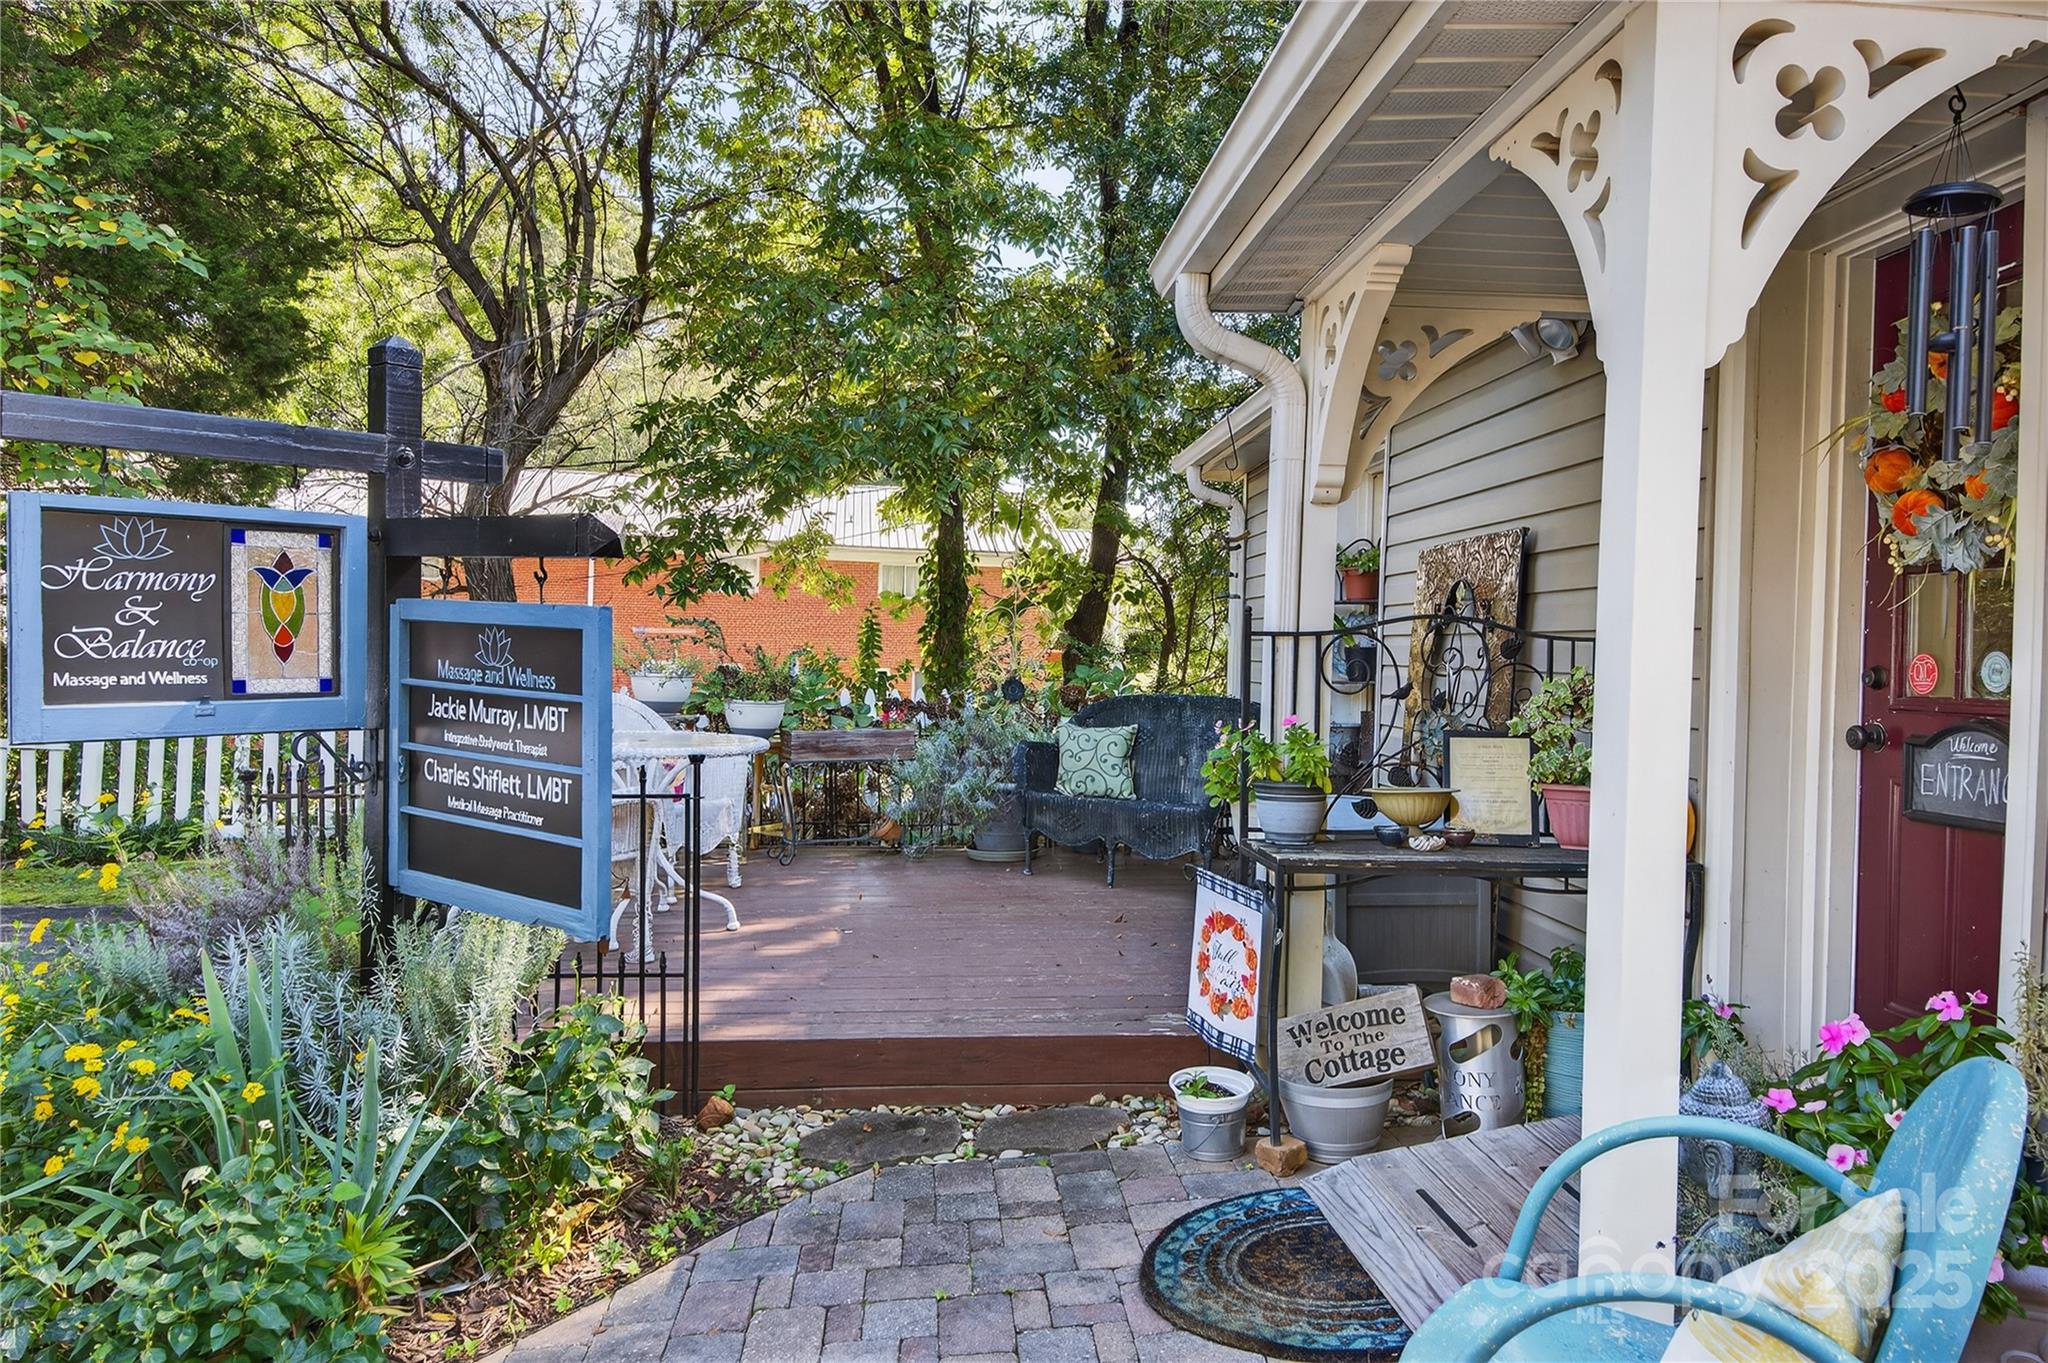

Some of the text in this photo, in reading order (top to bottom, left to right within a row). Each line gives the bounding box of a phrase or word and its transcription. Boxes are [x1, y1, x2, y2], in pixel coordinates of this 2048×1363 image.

[41, 556, 216, 602] Harmony
[115, 595, 163, 626] &
[54, 626, 206, 659] Balance
[183, 656, 218, 668] co-op
[437, 659, 556, 689] Massage and Wellness
[53, 671, 208, 689] Massage and Wellness
[428, 694, 568, 733] Jackie Murray, LMBT
[1951, 736, 1998, 755] Welcome
[424, 758, 573, 804] Charles Shiflett, LMBT
[1286, 1007, 1406, 1048] Welcome
[1320, 1030, 1385, 1054] To The
[1305, 1047, 1406, 1084] Cottage
